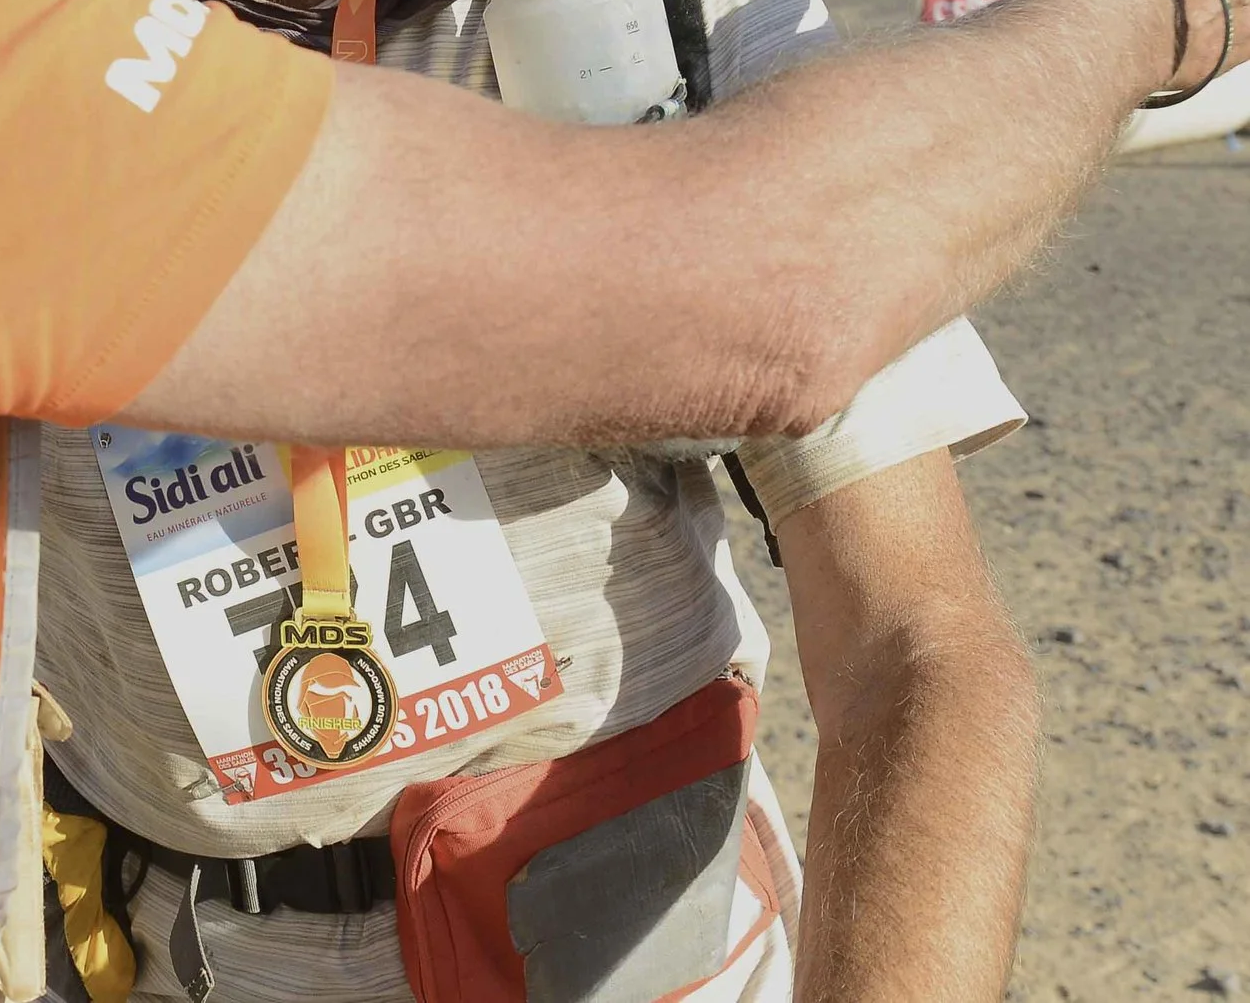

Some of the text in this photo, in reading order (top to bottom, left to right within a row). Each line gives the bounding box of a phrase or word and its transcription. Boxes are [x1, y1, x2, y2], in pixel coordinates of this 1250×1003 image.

[125, 443, 266, 525] Sidi ali
[347, 450, 442, 486] THON DES SABL
[146, 492, 268, 542] EAU MINÉRALE NATURELLE
[176, 540, 300, 608] ROBER
[364, 488, 452, 539] GBR
[284, 623, 370, 646] MDS
[274, 657, 312, 751] MARATHON DES SABLES
[299, 717, 363, 731] FINISHER
[352, 658, 385, 752] SAHARA SUD MAROCAIN
[415, 673, 510, 740] 2018
[216, 750, 254, 764] MARATHON
